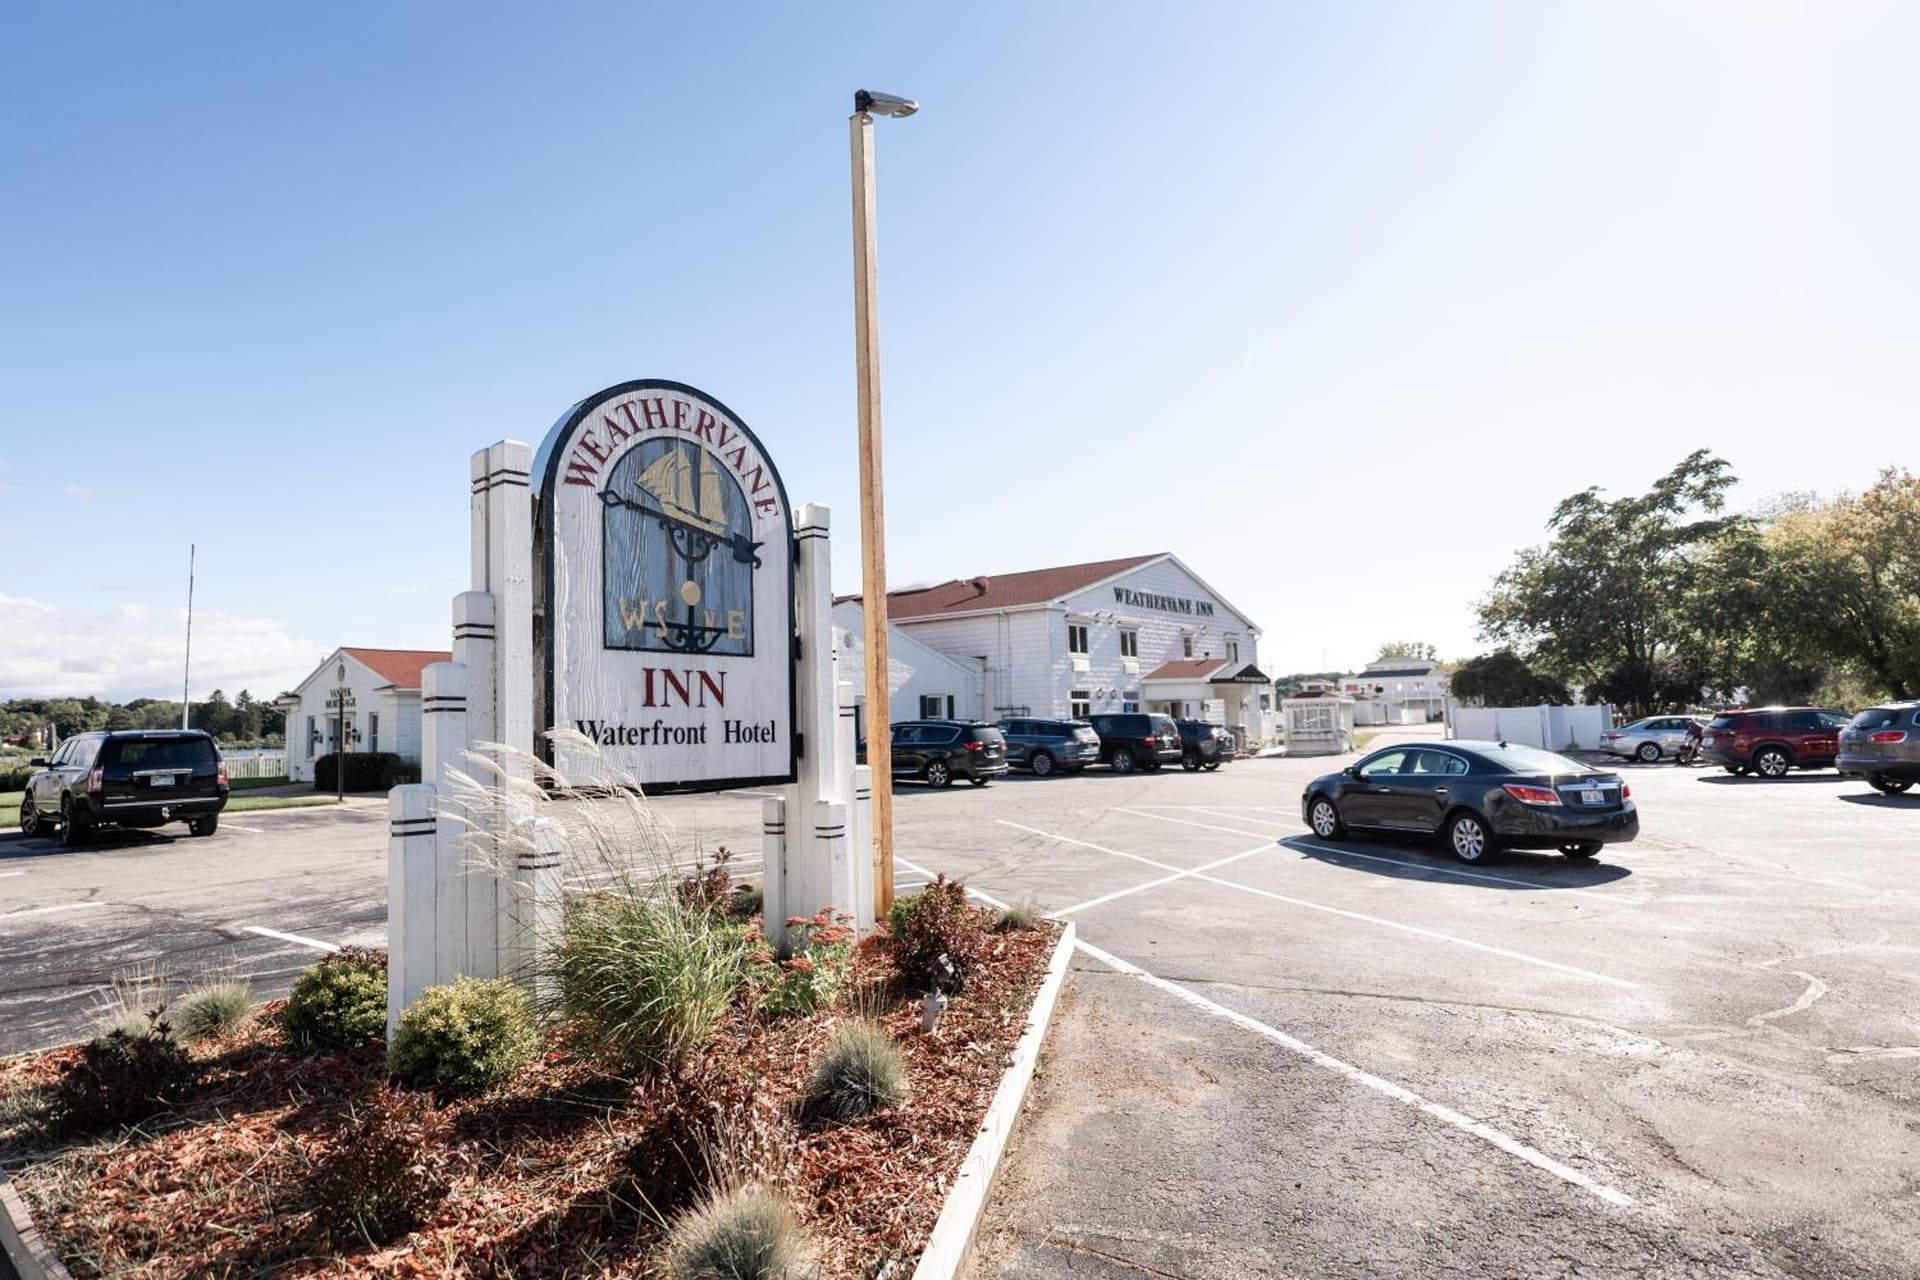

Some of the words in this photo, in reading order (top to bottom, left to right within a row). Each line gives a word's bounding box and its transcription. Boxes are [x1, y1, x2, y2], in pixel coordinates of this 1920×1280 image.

[562, 397, 779, 520] WEATHERVANE
[655, 600, 669, 638] S
[727, 609, 747, 640] E
[1113, 587, 1192, 614] WEATHERVANE
[1195, 601, 1214, 616] INN
[641, 667, 728, 708] INN
[575, 719, 707, 746] Waterfront
[724, 719, 776, 744] Hotel
